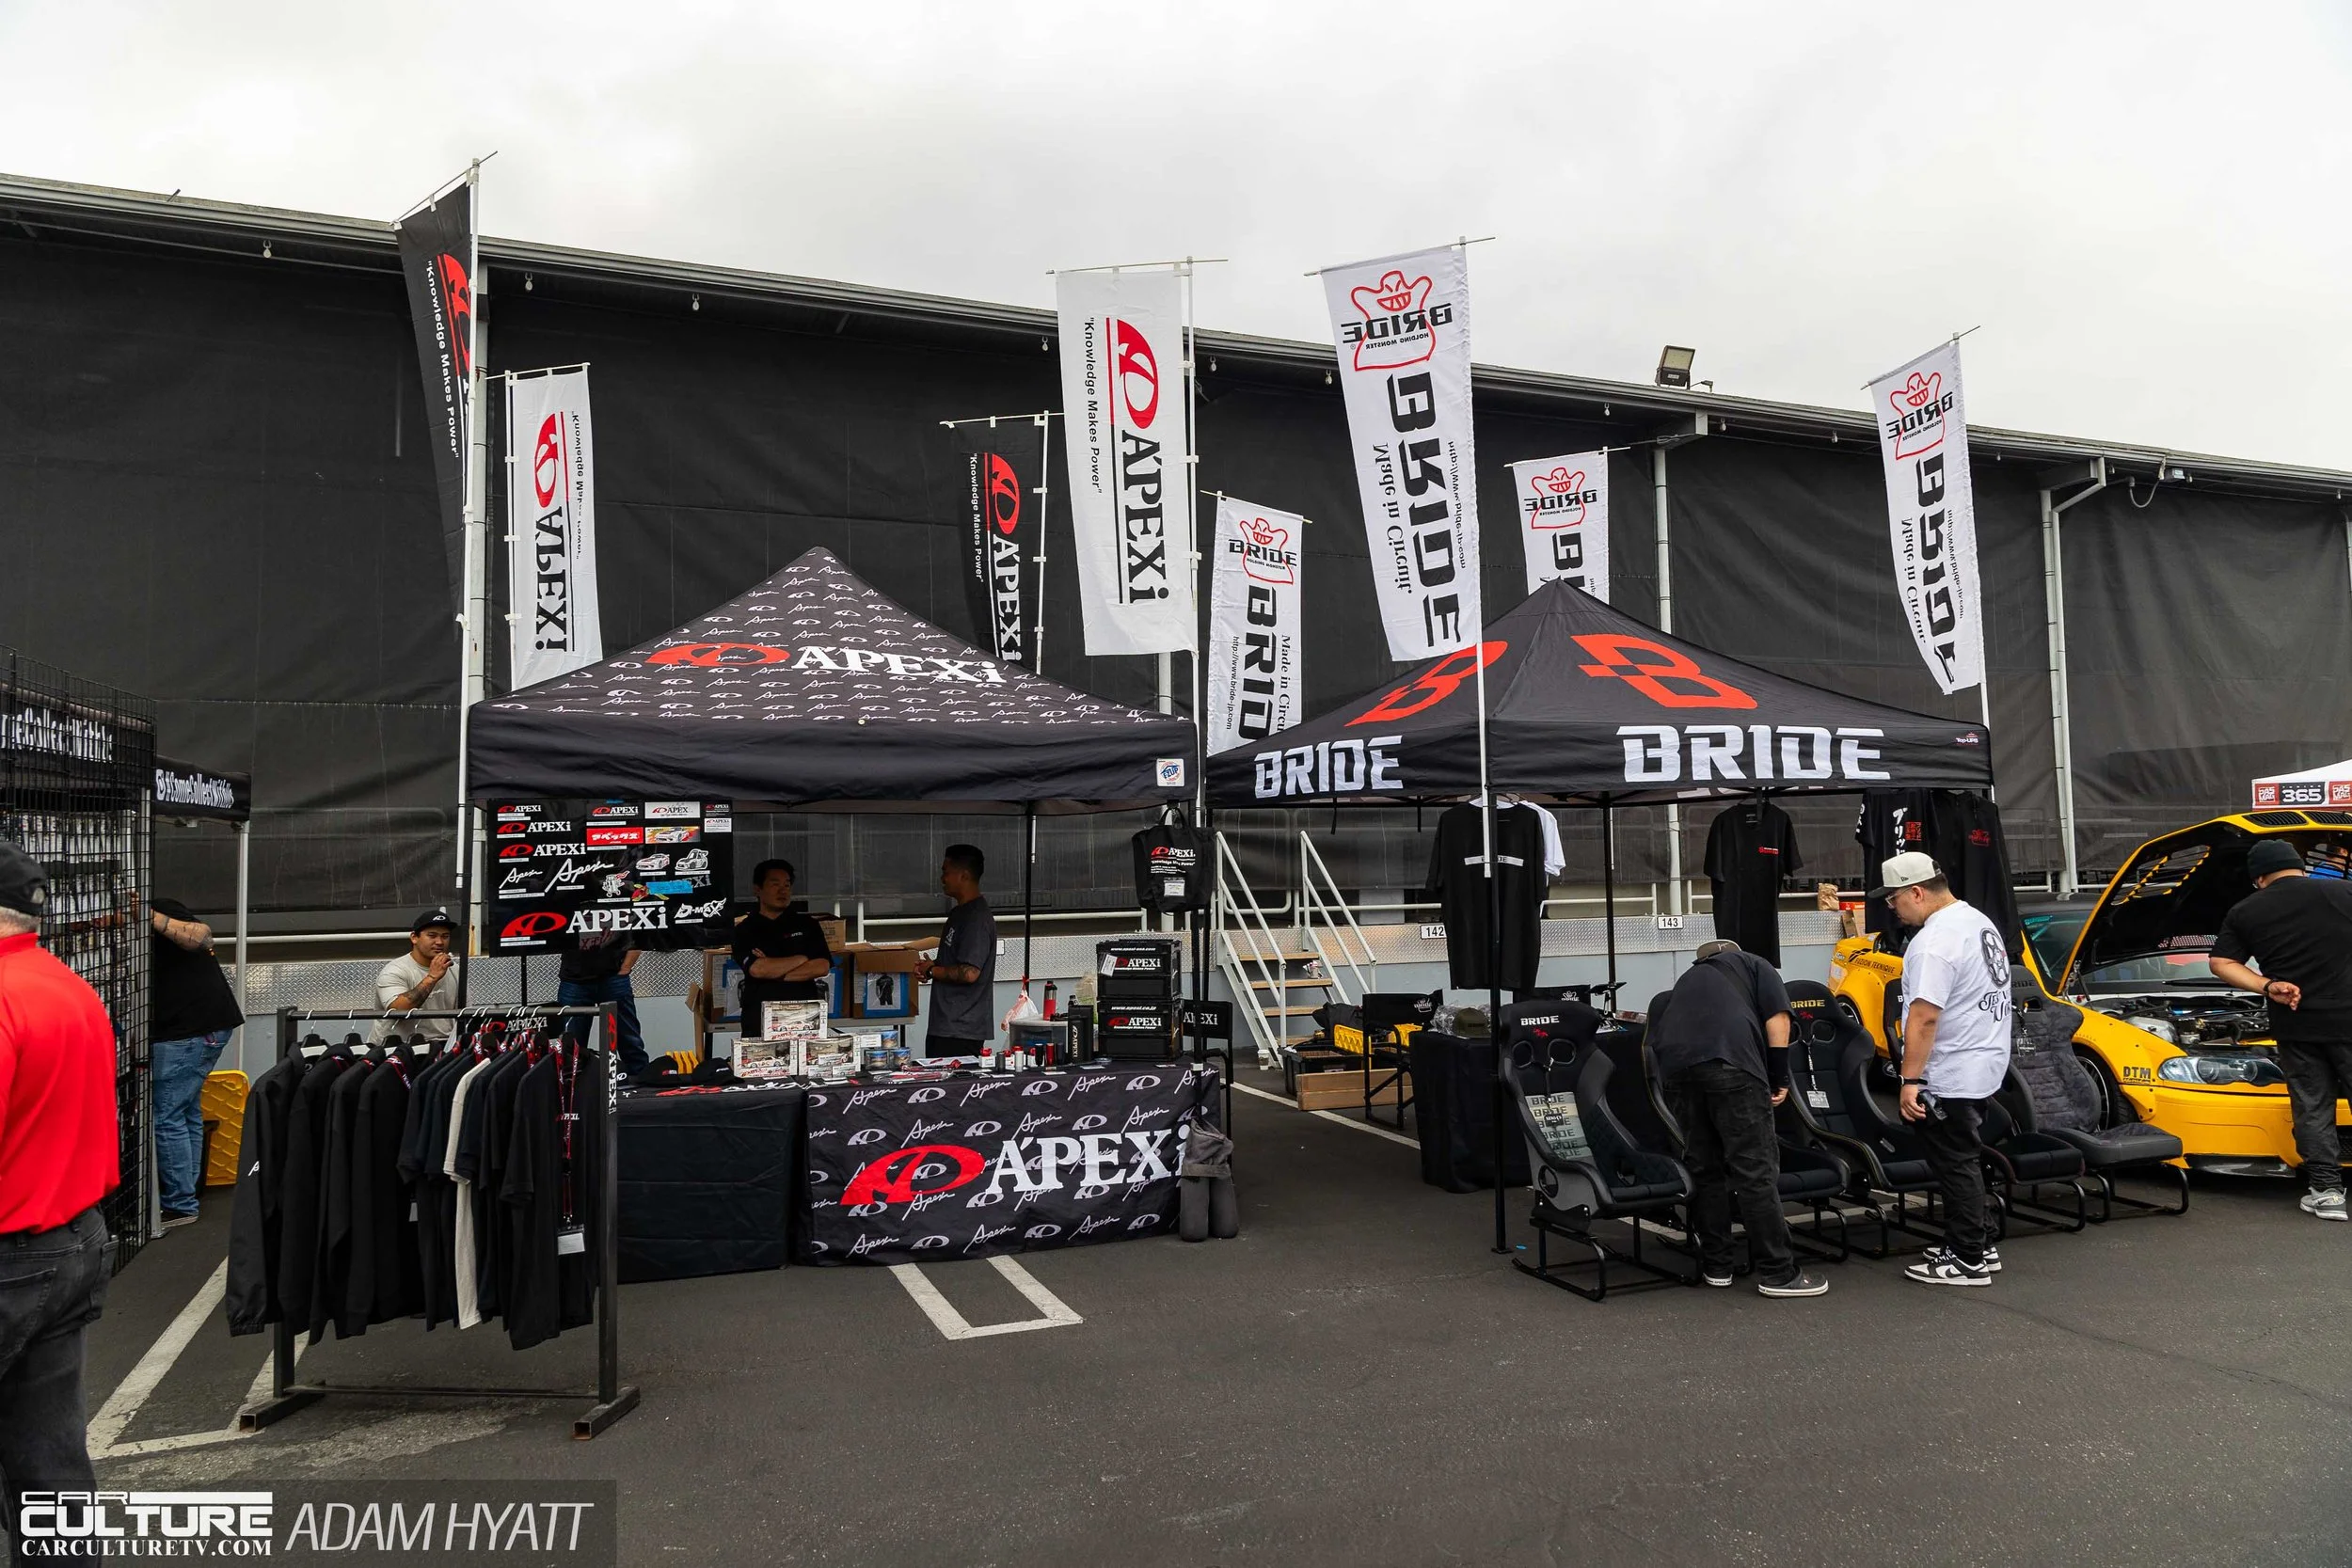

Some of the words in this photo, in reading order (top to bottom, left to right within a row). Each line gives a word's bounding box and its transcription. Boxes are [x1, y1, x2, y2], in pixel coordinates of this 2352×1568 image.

[440, 354, 453, 403] Makes
[1088, 399, 1098, 442] Makes
[973, 513, 981, 545] Makes
[1228, 539, 1297, 567] BRIDE
[1238, 585, 1277, 741] BRID
[1280, 635, 1292, 673] Made
[1280, 675, 1292, 689] in
[1277, 693, 1291, 733] Circu
[1253, 735, 1404, 800] BRIDE
[1615, 724, 1891, 783] BRIDE
[2281, 788, 2322, 802] 365
[1425, 927, 1444, 937] 142
[1662, 917, 1679, 927] 143
[1790, 999, 1826, 1009] BRIDE
[1520, 1015, 1560, 1026] BRIDE
[2123, 1066, 2151, 1079] DTM
